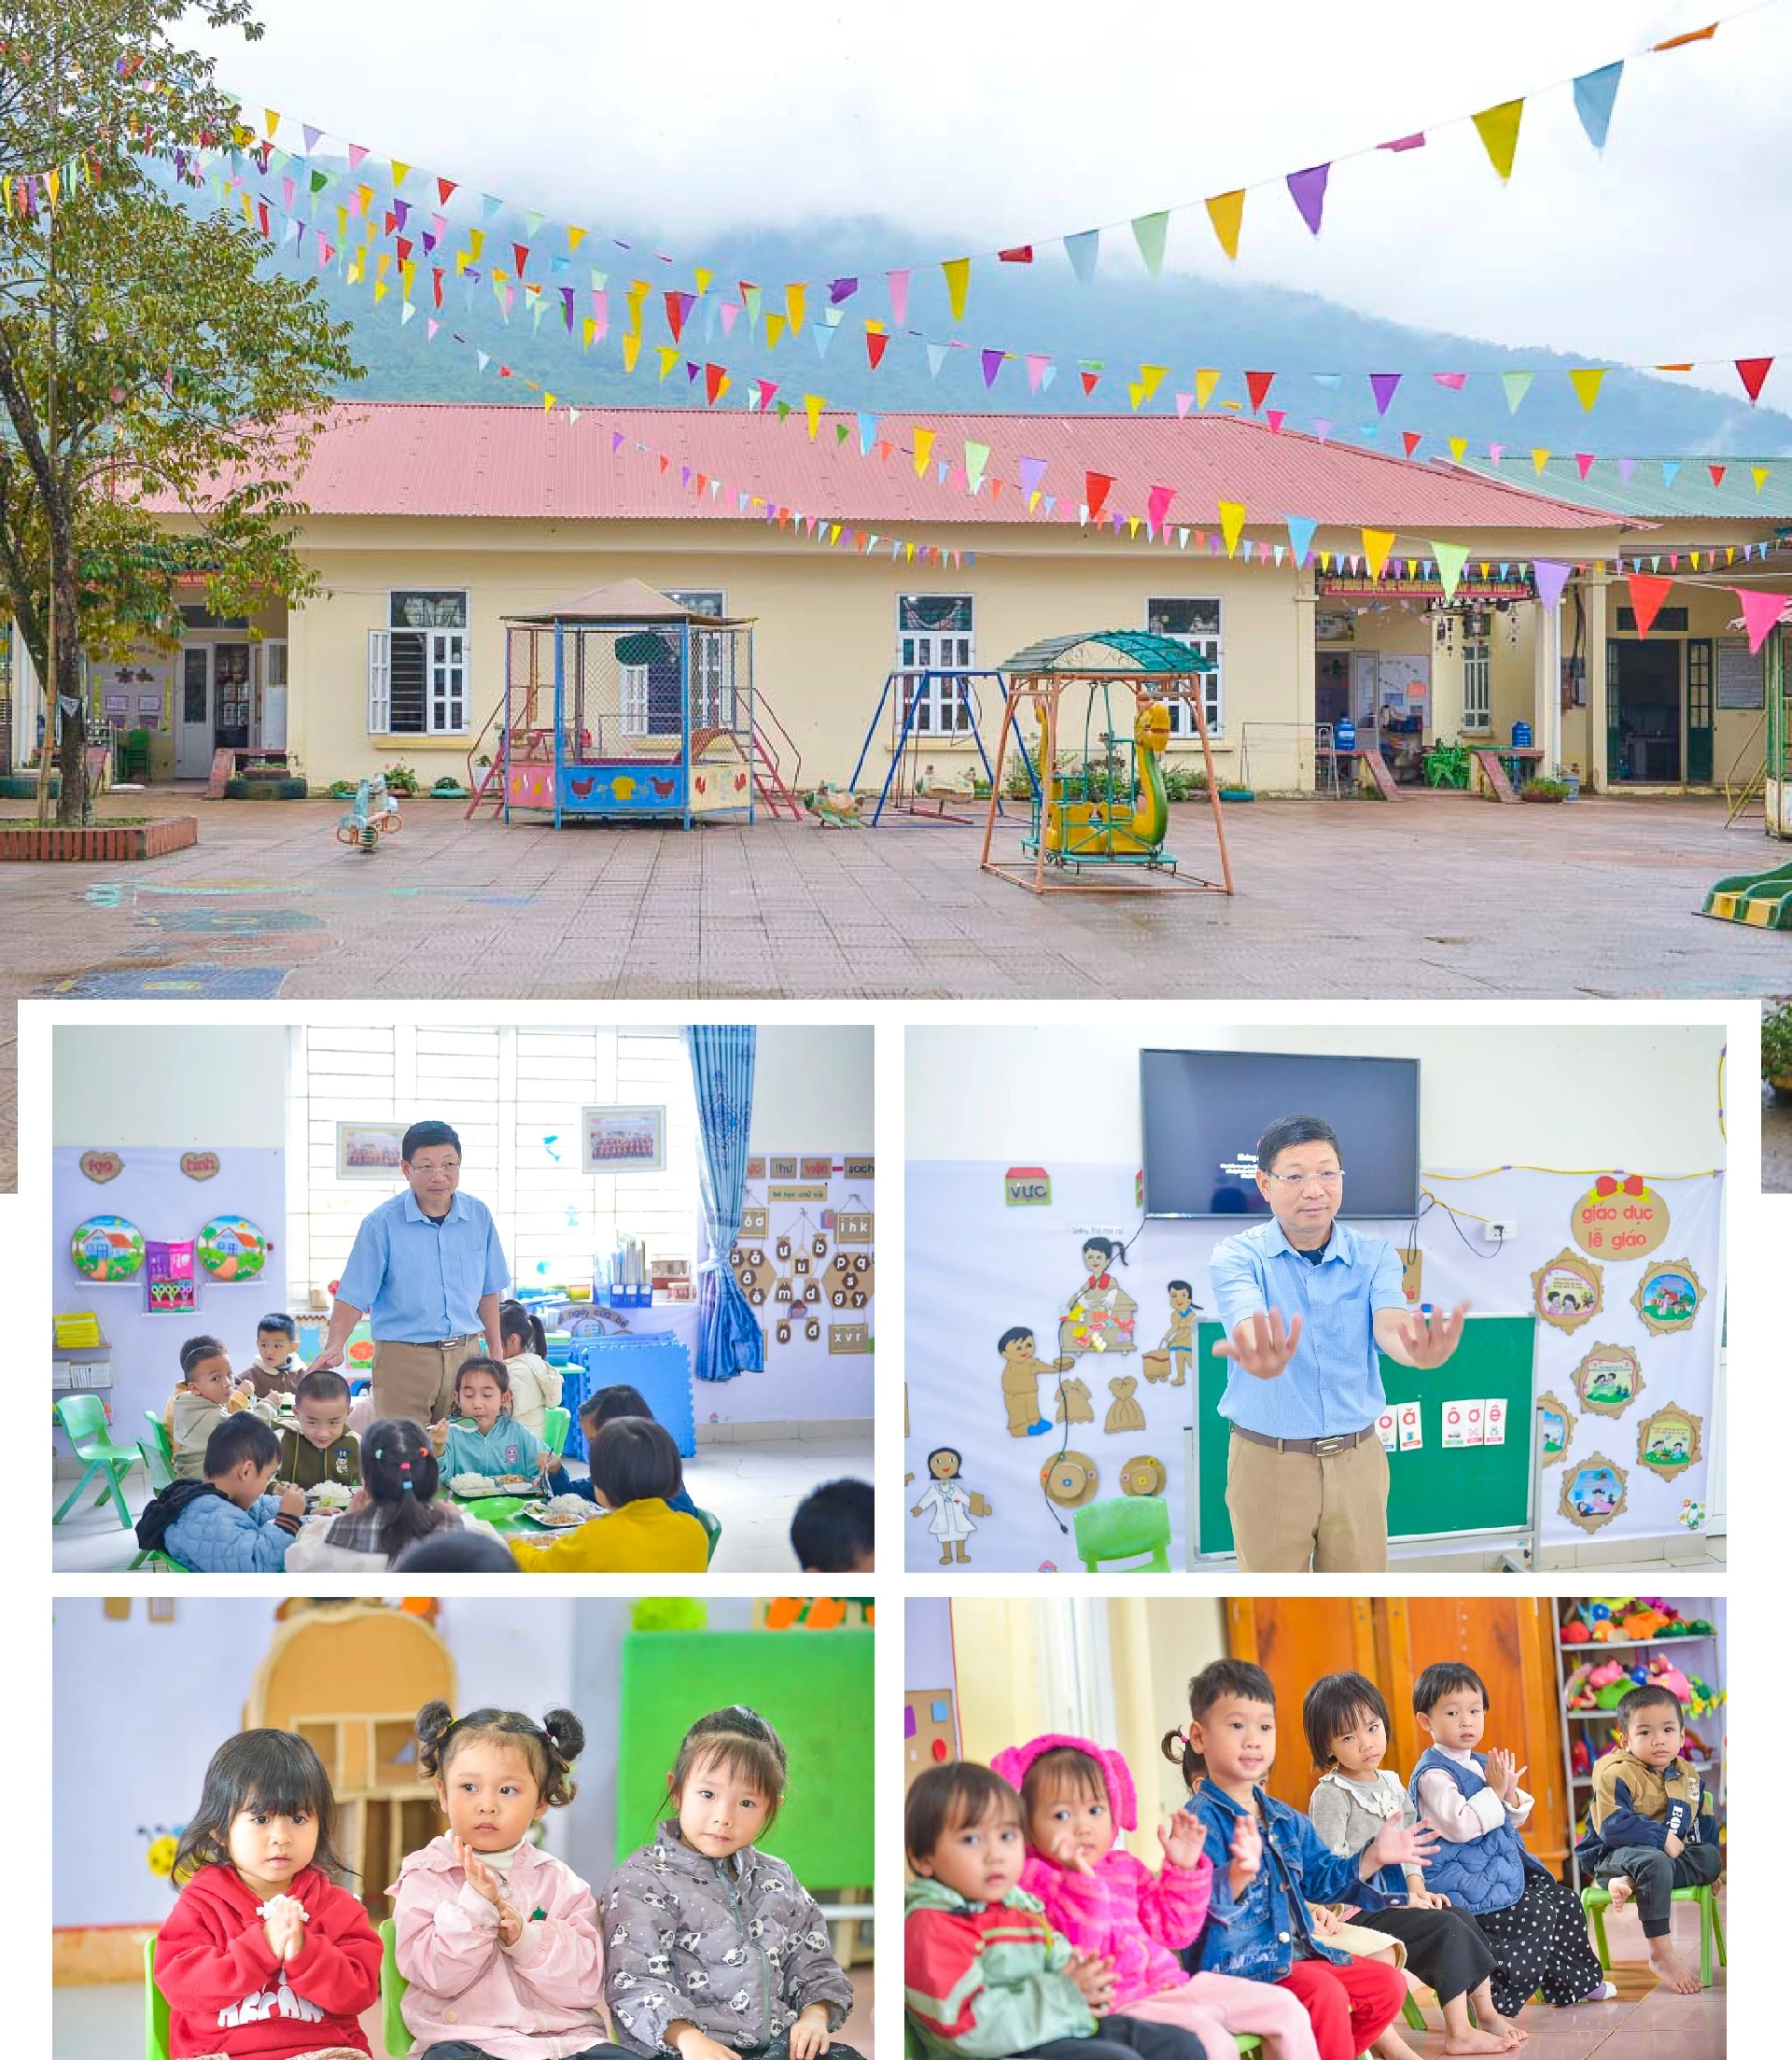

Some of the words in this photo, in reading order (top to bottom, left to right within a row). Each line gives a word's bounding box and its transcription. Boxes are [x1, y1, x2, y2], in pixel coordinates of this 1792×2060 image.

[1010, 1184, 1047, 1202] vực
[1581, 1201, 1617, 1224] giáo
[1623, 1204, 1654, 1226] dục
[860, 1221, 868, 1232] k
[1588, 1227, 1603, 1248] lễ
[1611, 1228, 1646, 1251] giáo
[815, 1240, 824, 1253] b
[836, 1258, 846, 1269] p
[857, 1257, 866, 1269] q
[847, 1276, 854, 1286] s
[777, 1291, 791, 1299] m
[856, 1294, 864, 1305] y
[779, 1328, 789, 1338] n
[834, 1333, 842, 1341] x
[845, 1333, 852, 1341] v
[855, 1333, 861, 1341] r
[1379, 1415, 1393, 1429] o
[1403, 1408, 1416, 1425] ă
[1447, 1407, 1461, 1424] ô
[1468, 1408, 1480, 1422] ơ
[1490, 1405, 1501, 1422] ê
